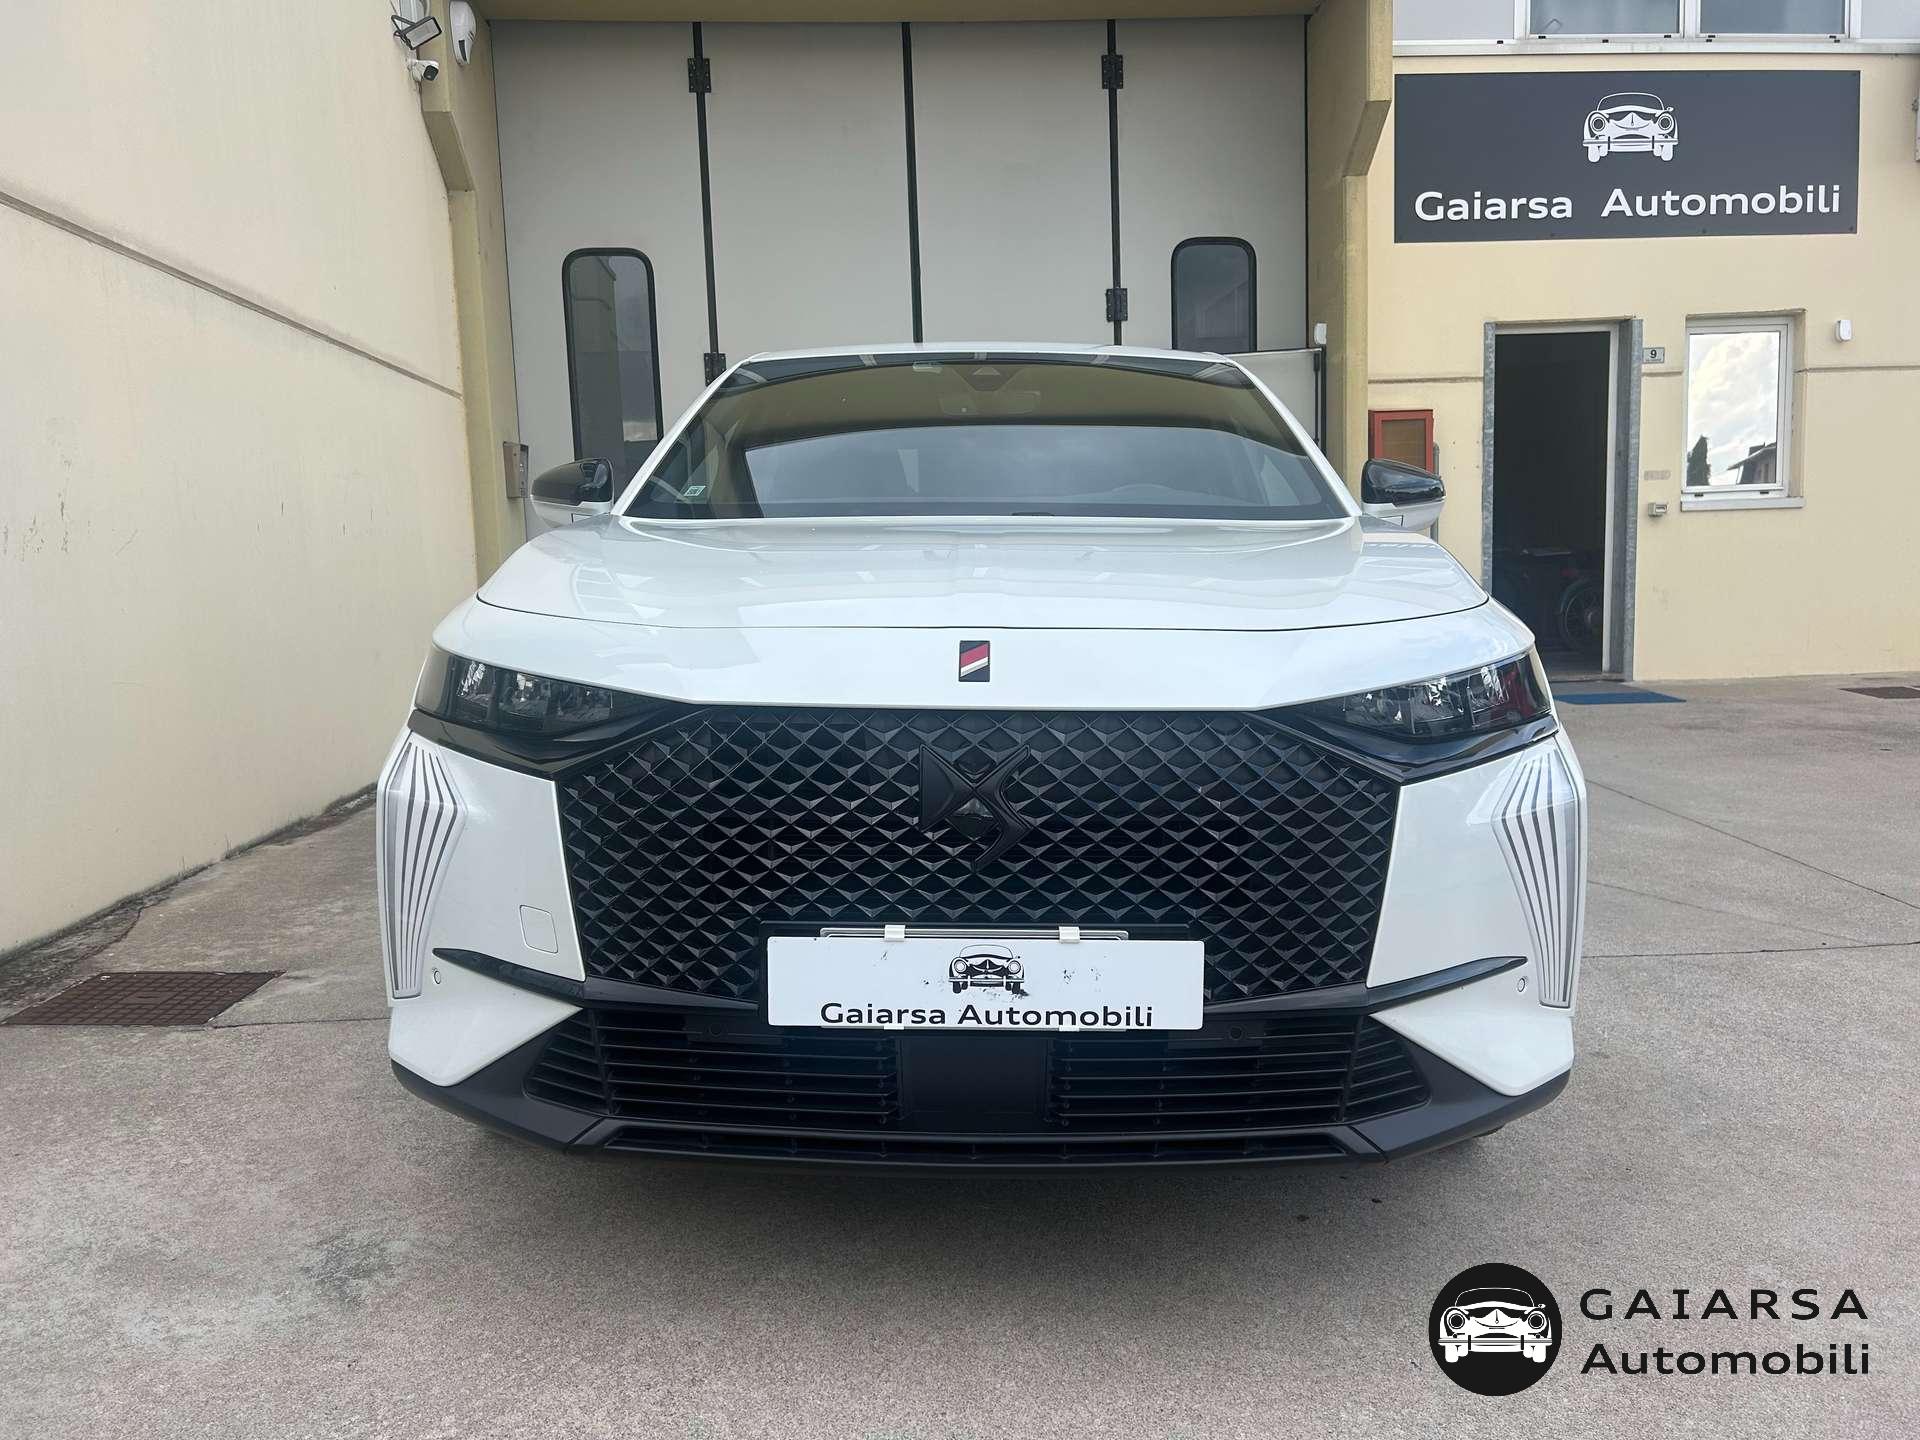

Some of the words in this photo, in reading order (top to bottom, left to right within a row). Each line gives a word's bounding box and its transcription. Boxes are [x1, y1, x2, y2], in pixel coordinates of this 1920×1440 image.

[1414, 190, 1573, 221] Gaiarsa
[1600, 184, 1840, 217] Automobili
[1650, 349, 1657, 359] 9
[820, 1002, 946, 1025] Gaiarsa
[957, 1003, 1153, 1027] Automobili
